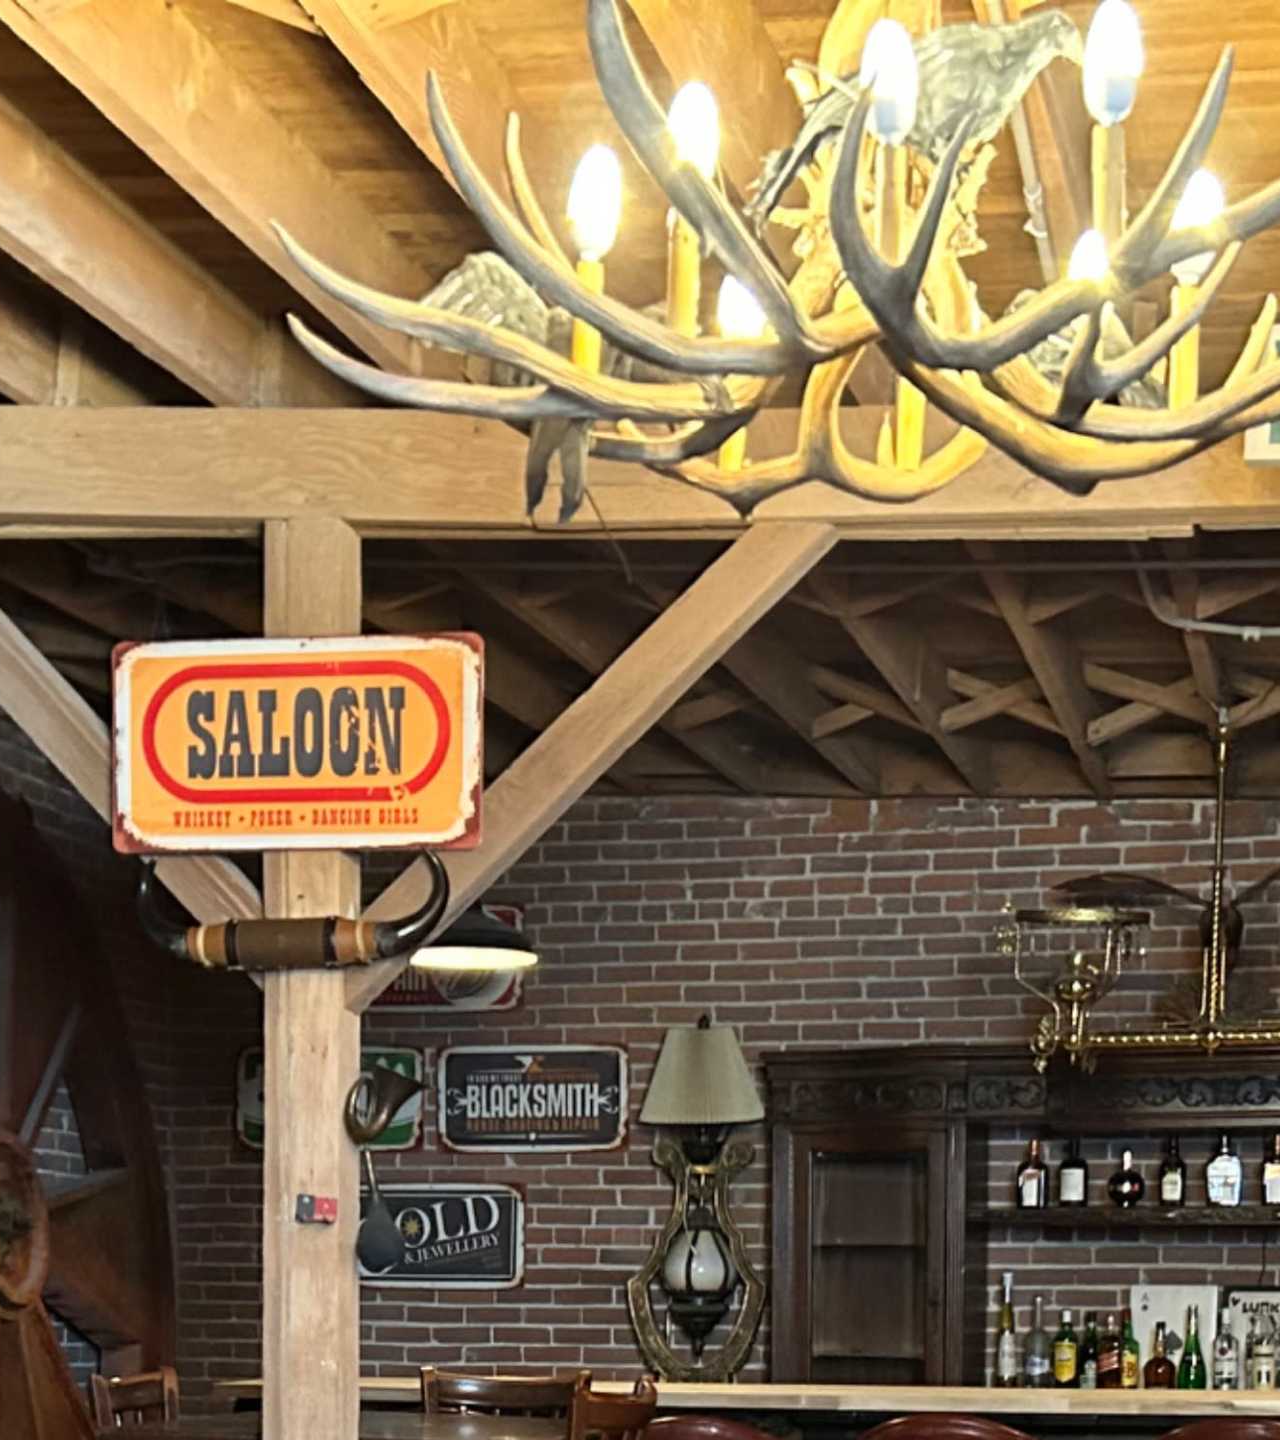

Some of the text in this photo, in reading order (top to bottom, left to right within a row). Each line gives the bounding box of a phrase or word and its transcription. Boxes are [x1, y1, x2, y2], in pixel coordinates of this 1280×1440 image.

[186, 685, 406, 780] SALOON
[173, 807, 418, 828] WHISKEY POKER DANCING GIRLS
[466, 1083, 600, 1119] BLACKSMITH
